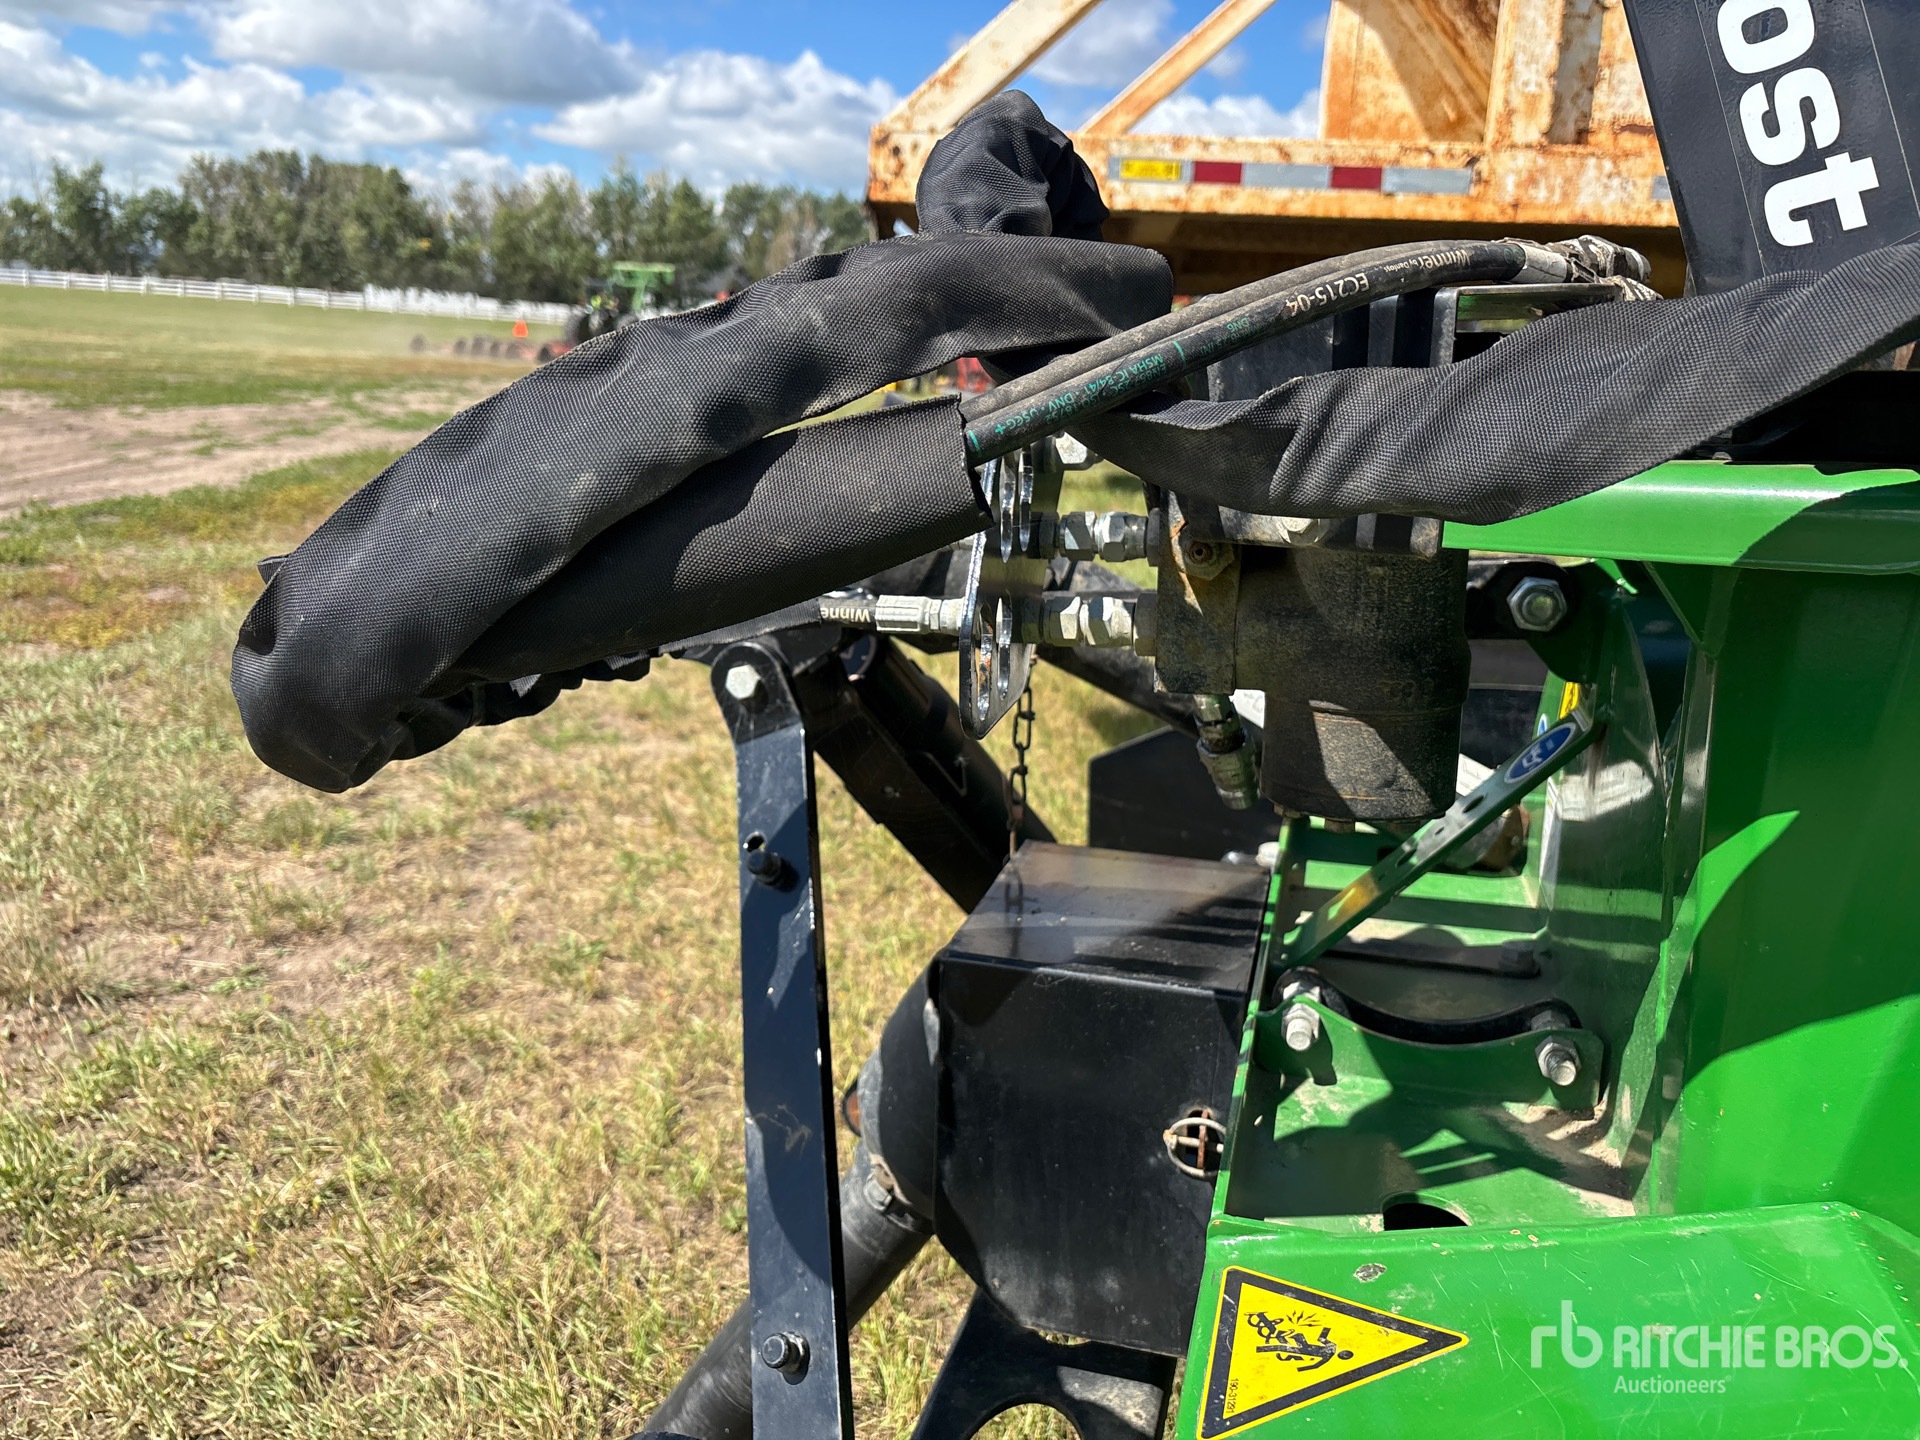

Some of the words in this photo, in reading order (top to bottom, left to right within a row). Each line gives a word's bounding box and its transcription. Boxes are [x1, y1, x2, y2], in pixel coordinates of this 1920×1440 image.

[1383, 260, 1409, 273] Danfoss
[1418, 249, 1470, 270] Winner
[1285, 272, 1370, 316] EC215-04
[1129, 353, 1164, 375] MSHA
[820, 607, 871, 623] Winne
